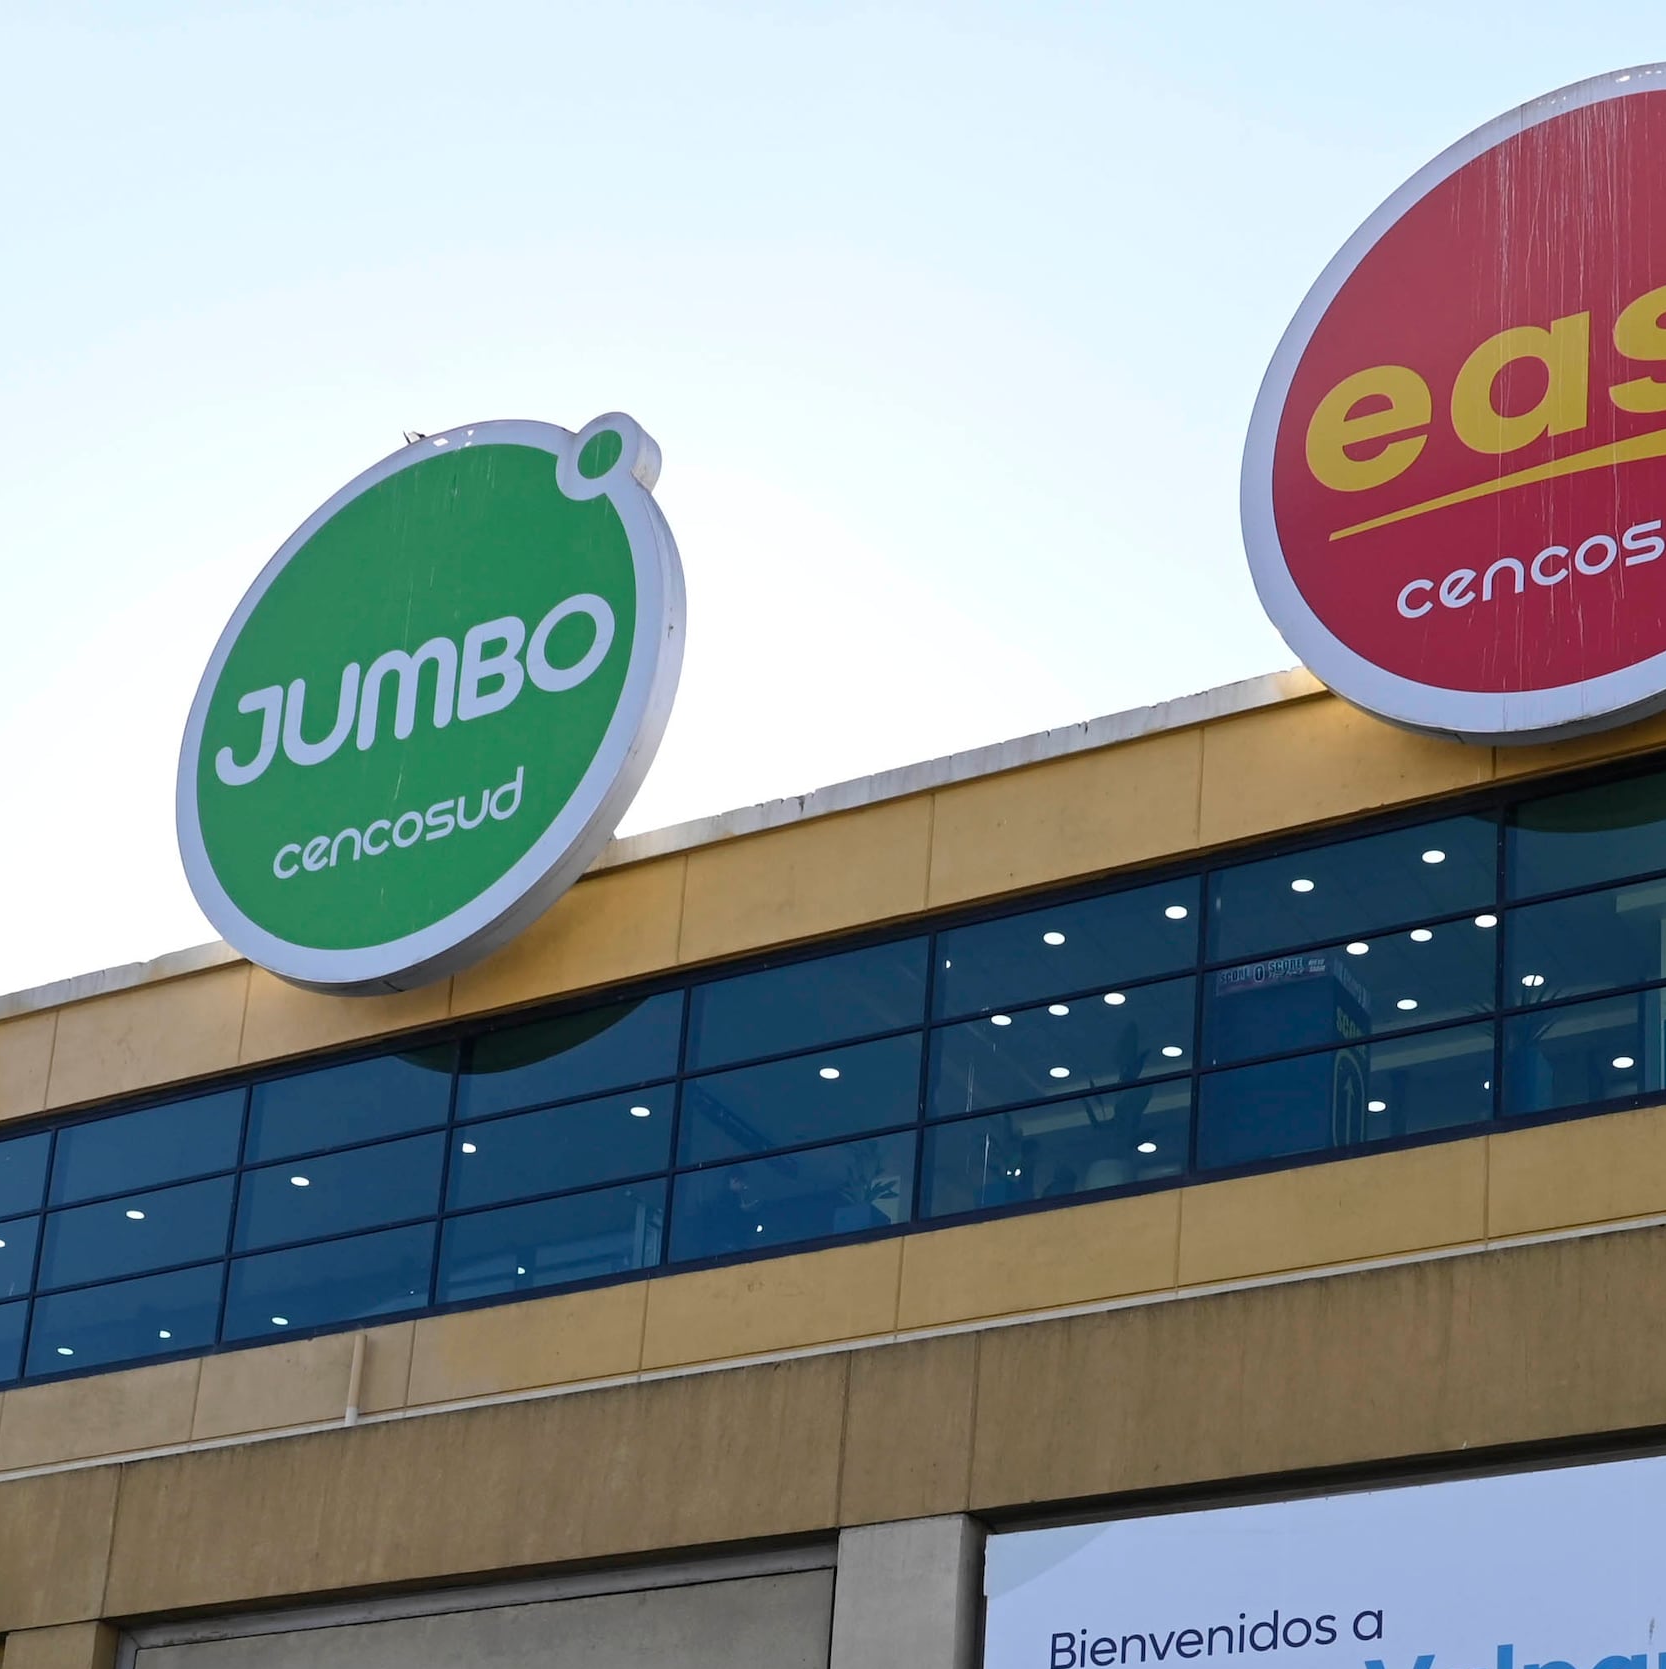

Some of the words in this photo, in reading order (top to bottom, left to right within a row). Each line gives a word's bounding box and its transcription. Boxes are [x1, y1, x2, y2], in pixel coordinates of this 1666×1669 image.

[214, 592, 616, 787] JUMBO
[271, 765, 524, 880] cencosud
[1352, 1609, 1385, 1643] a
